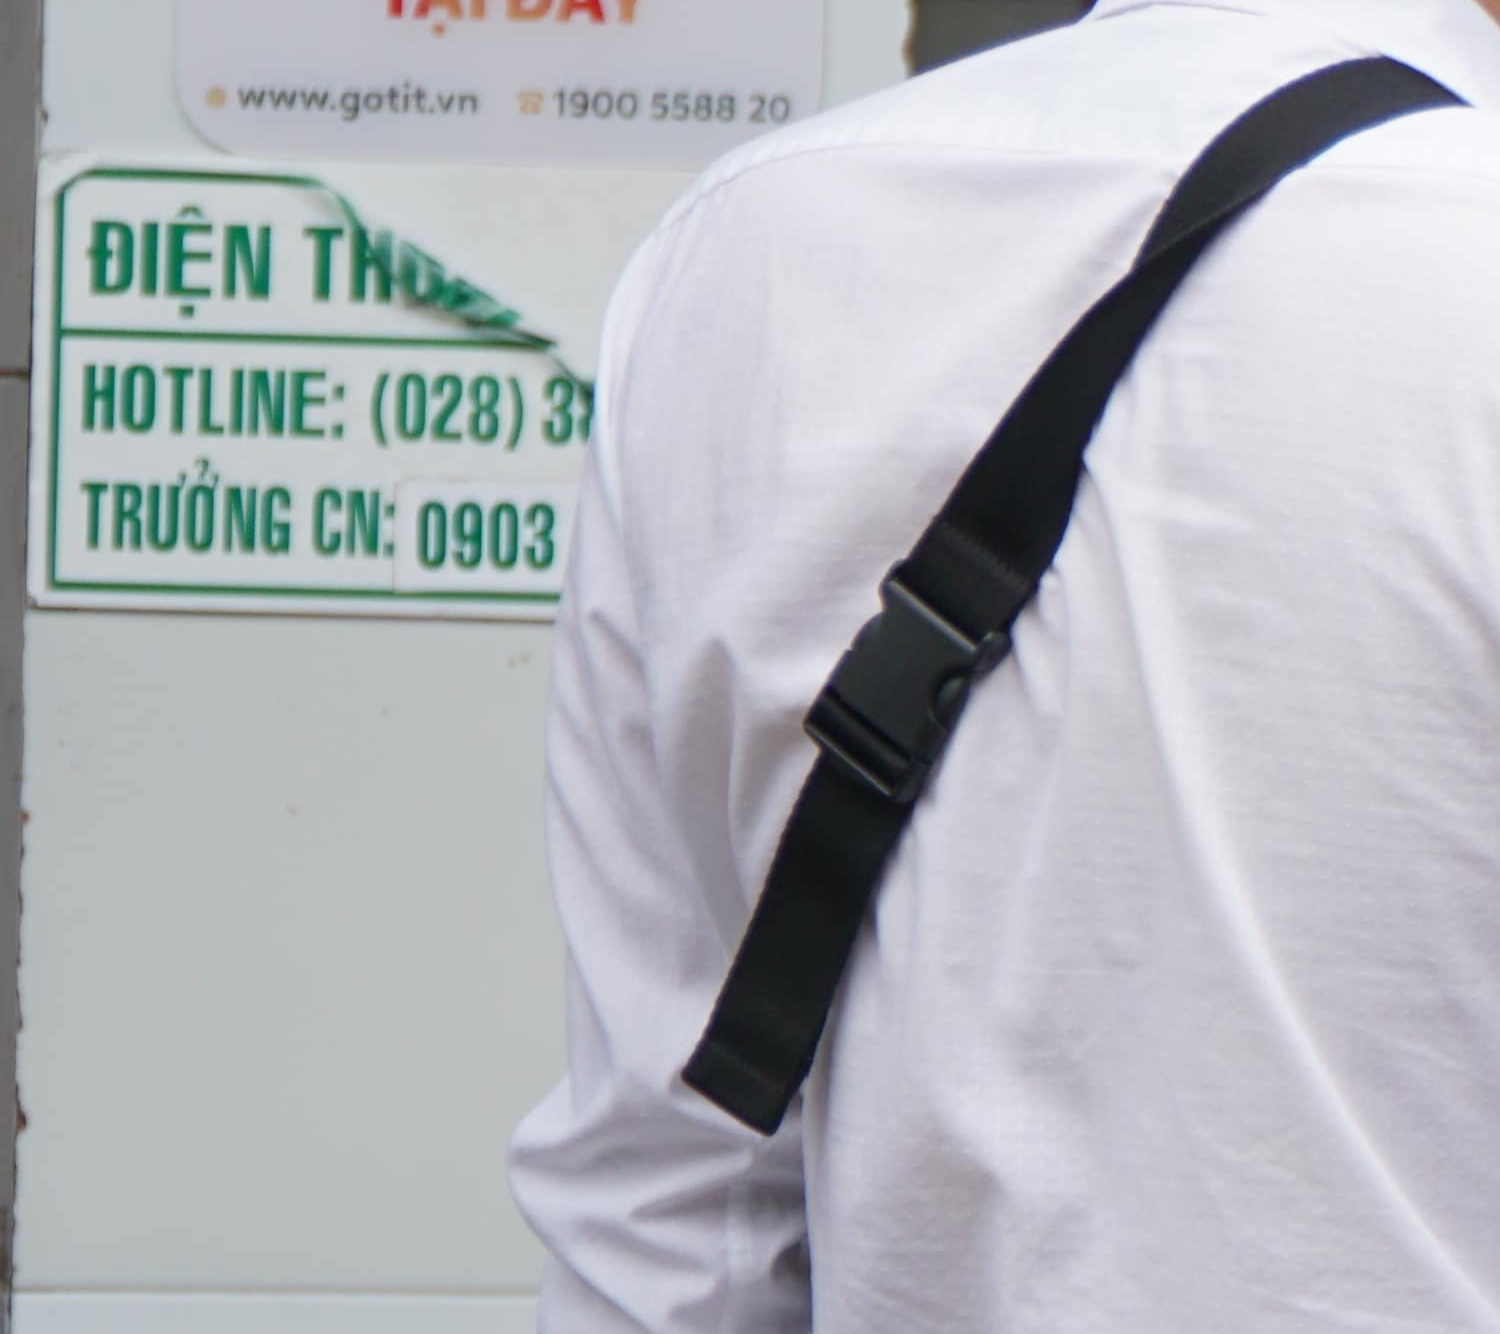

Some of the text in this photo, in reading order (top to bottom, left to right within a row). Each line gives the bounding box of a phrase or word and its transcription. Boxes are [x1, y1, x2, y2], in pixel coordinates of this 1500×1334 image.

[237, 81, 791, 124] www.gotit.vn 1900 5588 20
[87, 205, 272, 319] ĐIỆN
[81, 364, 347, 441] HOTLINE:
[371, 372, 526, 451] (028)
[80, 457, 557, 573] TRƯỞNG CN: 0903
